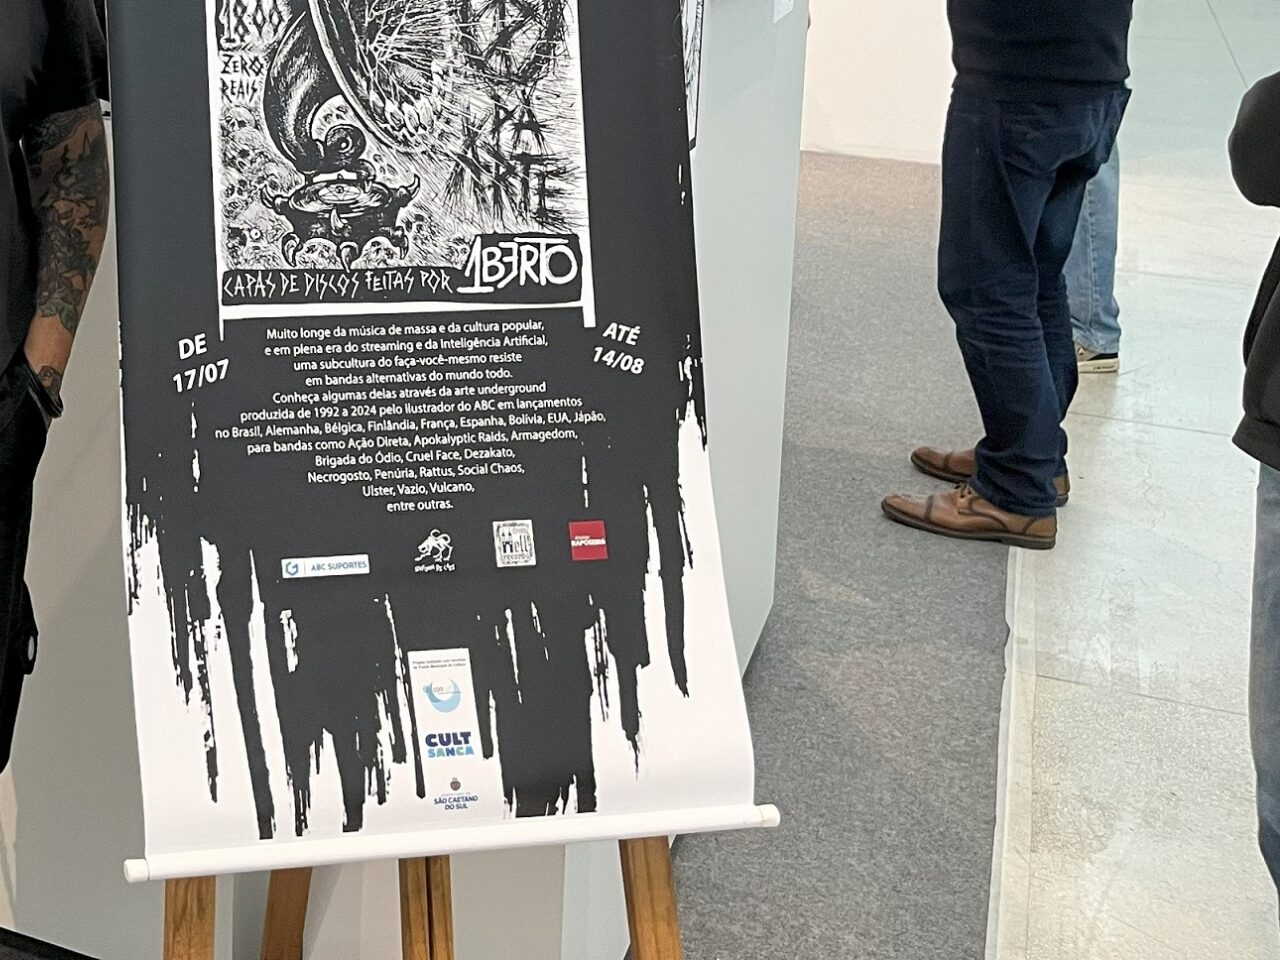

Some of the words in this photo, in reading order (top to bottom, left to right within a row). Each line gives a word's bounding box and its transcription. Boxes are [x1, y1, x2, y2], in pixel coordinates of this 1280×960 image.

[221, 53, 266, 76] ZERO
[220, 78, 259, 103] REAIS
[224, 271, 275, 298] CAPAS
[280, 273, 300, 297] DE
[304, 271, 359, 300] DISCOS
[365, 270, 415, 294] FEITAS
[420, 269, 453, 294] POR
[266, 328, 298, 339] Muito
[300, 327, 331, 340] longe
[332, 326, 346, 337] da
[348, 325, 386, 336] música
[388, 324, 402, 335] de
[404, 325, 437, 334] massa
[438, 325, 446, 333] e
[447, 322, 461, 332] da
[462, 321, 500, 332] cultura
[502, 319, 544, 333] popular,
[602, 322, 641, 346] ATÉ
[178, 333, 208, 360] DE
[264, 347, 272, 355] e
[273, 346, 290, 355] em
[292, 343, 323, 356] plena
[324, 344, 342, 353] era
[344, 341, 358, 352] do
[360, 340, 414, 353] streaming
[415, 341, 422, 350] e
[424, 338, 438, 349] da
[440, 337, 501, 350] Inteligência
[502, 334, 548, 346] Artificial,
[293, 361, 317, 370] uma
[319, 357, 376, 369] subcultura
[377, 356, 392, 367] do
[393, 354, 487, 368] faça-você-mesmo
[488, 352, 522, 363] resiste
[592, 346, 645, 375] 14/08
[172, 358, 229, 393] 17/07
[304, 377, 322, 386] em
[324, 373, 364, 385] bandas
[365, 371, 427, 383] alternativas
[428, 370, 443, 381] do
[445, 368, 484, 380] mundo
[484, 367, 513, 378] todo.
[272, 391, 320, 404] Conheça
[321, 390, 367, 403] algumas
[368, 388, 397, 399] delas
[398, 386, 437, 398] através
[438, 385, 452, 396] da
[454, 386, 475, 396] arte
[477, 381, 546, 396] underground
[240, 408, 294, 423] produzida
[296, 407, 311, 418] de
[314, 406, 339, 417] 1992
[341, 408, 348, 416] a
[350, 405, 376, 416] 2024
[378, 403, 402, 417] pelo
[404, 401, 455, 413] ilustrador
[456, 400, 472, 411] do
[473, 399, 495, 410] ABC
[496, 401, 515, 410] em
[516, 397, 582, 410] lançamentos
[214, 430, 230, 438] no
[231, 425, 263, 437] Brasil,
[264, 423, 322, 436] Alemanha,
[324, 422, 366, 435] Bélgica,
[367, 419, 418, 431] Finlândia,
[420, 418, 458, 430] França,
[459, 415, 506, 429] Espanha,
[508, 413, 545, 425] Bolívia,
[547, 412, 572, 423] EUA,
[246, 444, 271, 455] para
[273, 440, 313, 452] bandas
[314, 440, 346, 450] como
[347, 437, 374, 450] Ação
[376, 436, 411, 447] Direta,
[413, 432, 476, 447] Apokalyptic
[477, 431, 509, 442] Raids,
[510, 428, 578, 442] Armagedom,
[315, 454, 356, 467] Brigada
[358, 453, 373, 464] do
[374, 450, 403, 463] Ódio,
[404, 450, 433, 462] Cruel
[435, 450, 462, 460] Face,
[464, 447, 515, 459] Dezakato,
[307, 471, 372, 484] Necrogosto,
[374, 467, 418, 479] Penúria,
[419, 466, 456, 477] Rattus,
[457, 463, 488, 475] Social
[489, 462, 525, 474] Chaos,
[362, 485, 396, 496] Ulster,
[396, 483, 428, 494] Vazio,
[428, 481, 475, 493] Vulcano,
[386, 501, 415, 512] entre
[416, 500, 453, 510] outras.
[311, 563, 327, 571] ABC
[328, 561, 367, 570] SUPORTES
[425, 731, 472, 748] CULT
[427, 745, 475, 759] SANCA
[434, 796, 448, 805] SÃO
[448, 795, 478, 804] CAETANO
